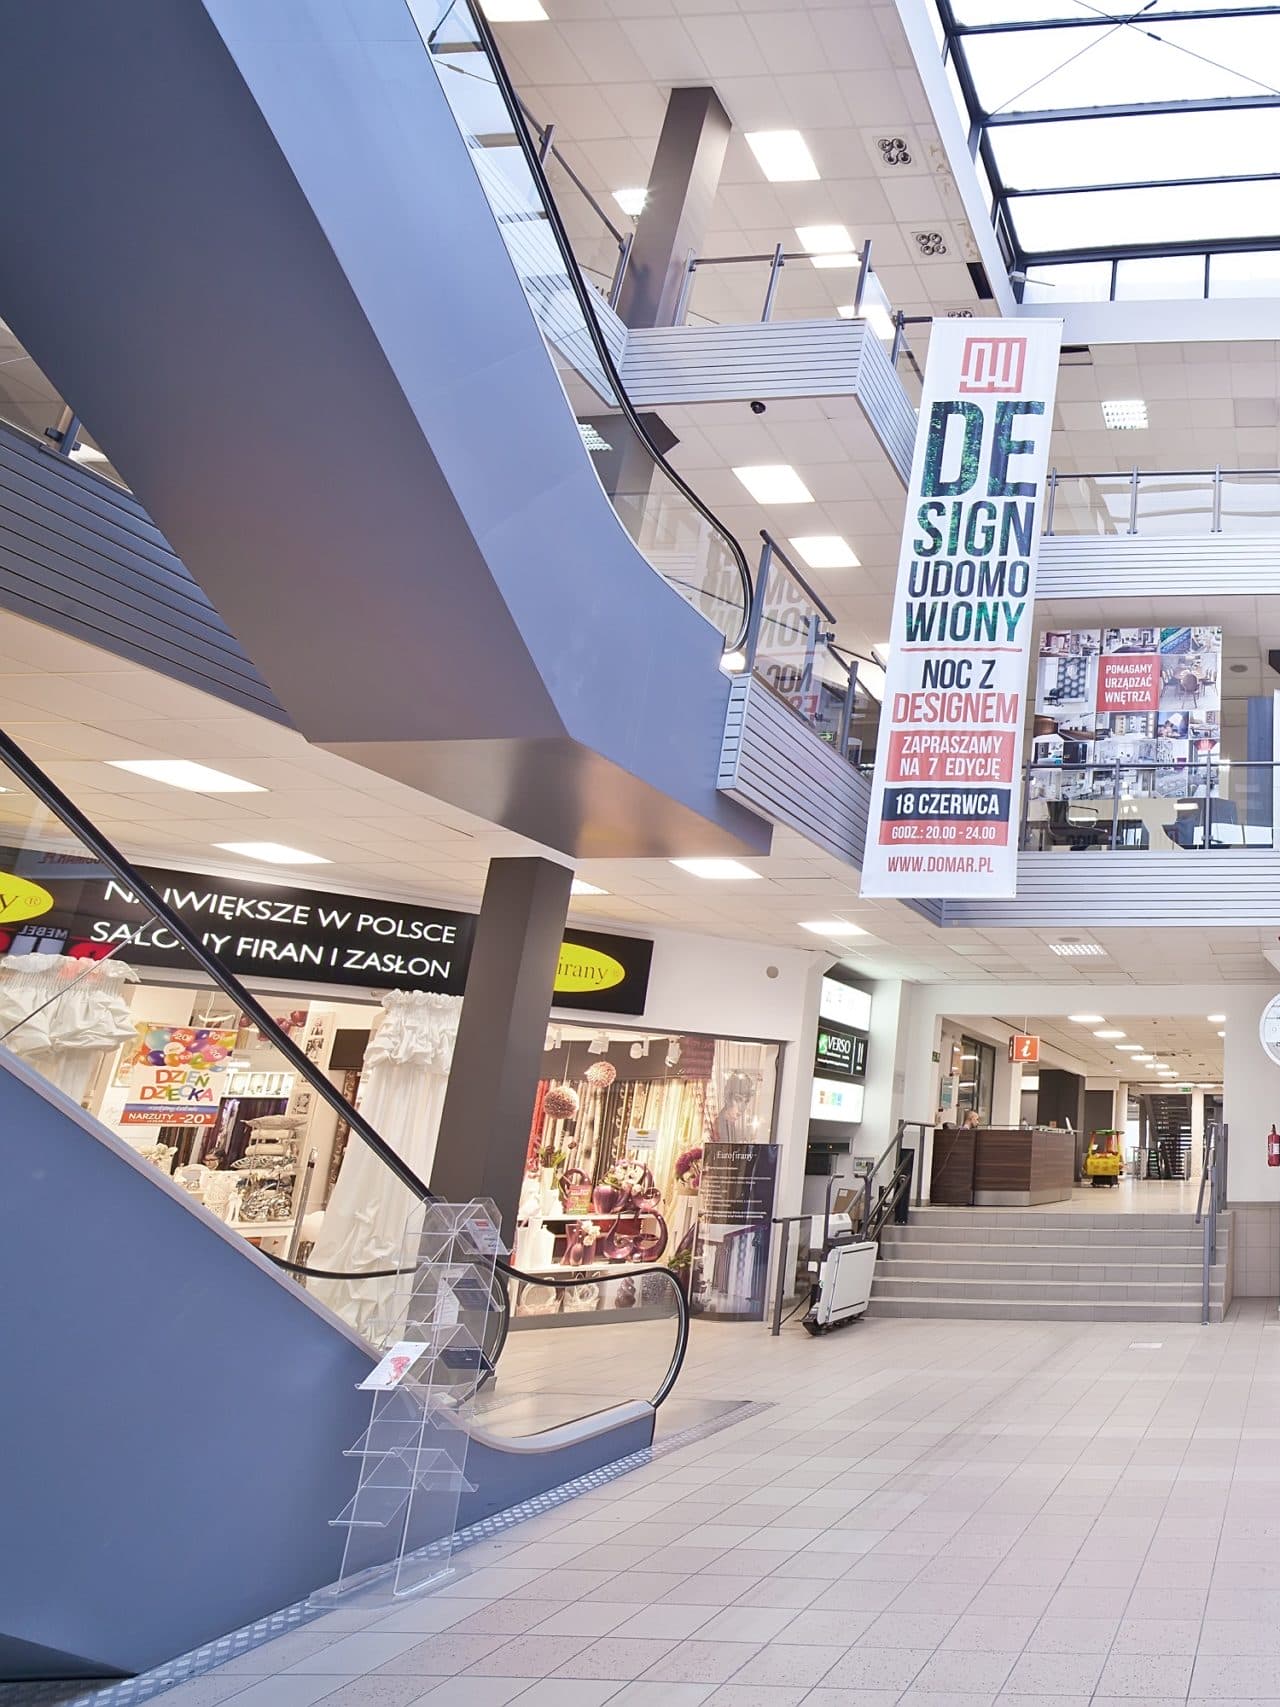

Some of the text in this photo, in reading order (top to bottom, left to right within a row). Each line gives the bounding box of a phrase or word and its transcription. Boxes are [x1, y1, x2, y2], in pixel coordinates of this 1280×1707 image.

[920, 401, 1045, 497] DE
[913, 501, 1035, 557] SIGN
[908, 560, 1030, 598] UDOMO
[906, 601, 1026, 642] WIONY
[921, 659, 996, 689] NOC Z
[1105, 664, 1152, 674] POMAGAMY
[1105, 674, 1152, 690] URZĄDZAĆ
[891, 692, 1019, 724] DESIGNEM
[1105, 691, 1151, 705] WNĘTRZA
[901, 735, 1003, 754] ZAPRASZAMY
[900, 757, 1001, 780] NA 7 EDYCJĘ
[895, 793, 1000, 815] 18 CZERWCA
[925, 826, 956, 839] 20.00
[965, 826, 996, 840] 24.00
[888, 856, 994, 873] WWW.DOMAR.PL
[318, 908, 351, 929] W
[357, 914, 457, 944] POLSCE
[236, 937, 324, 965] FIRAN
[330, 947, 338, 966] I
[343, 949, 451, 979] ZASŁON
[828, 1035, 851, 1054] VERSO
[155, 1069, 210, 1088] DZIEŃ
[128, 1112, 174, 1120] NARZUTY
